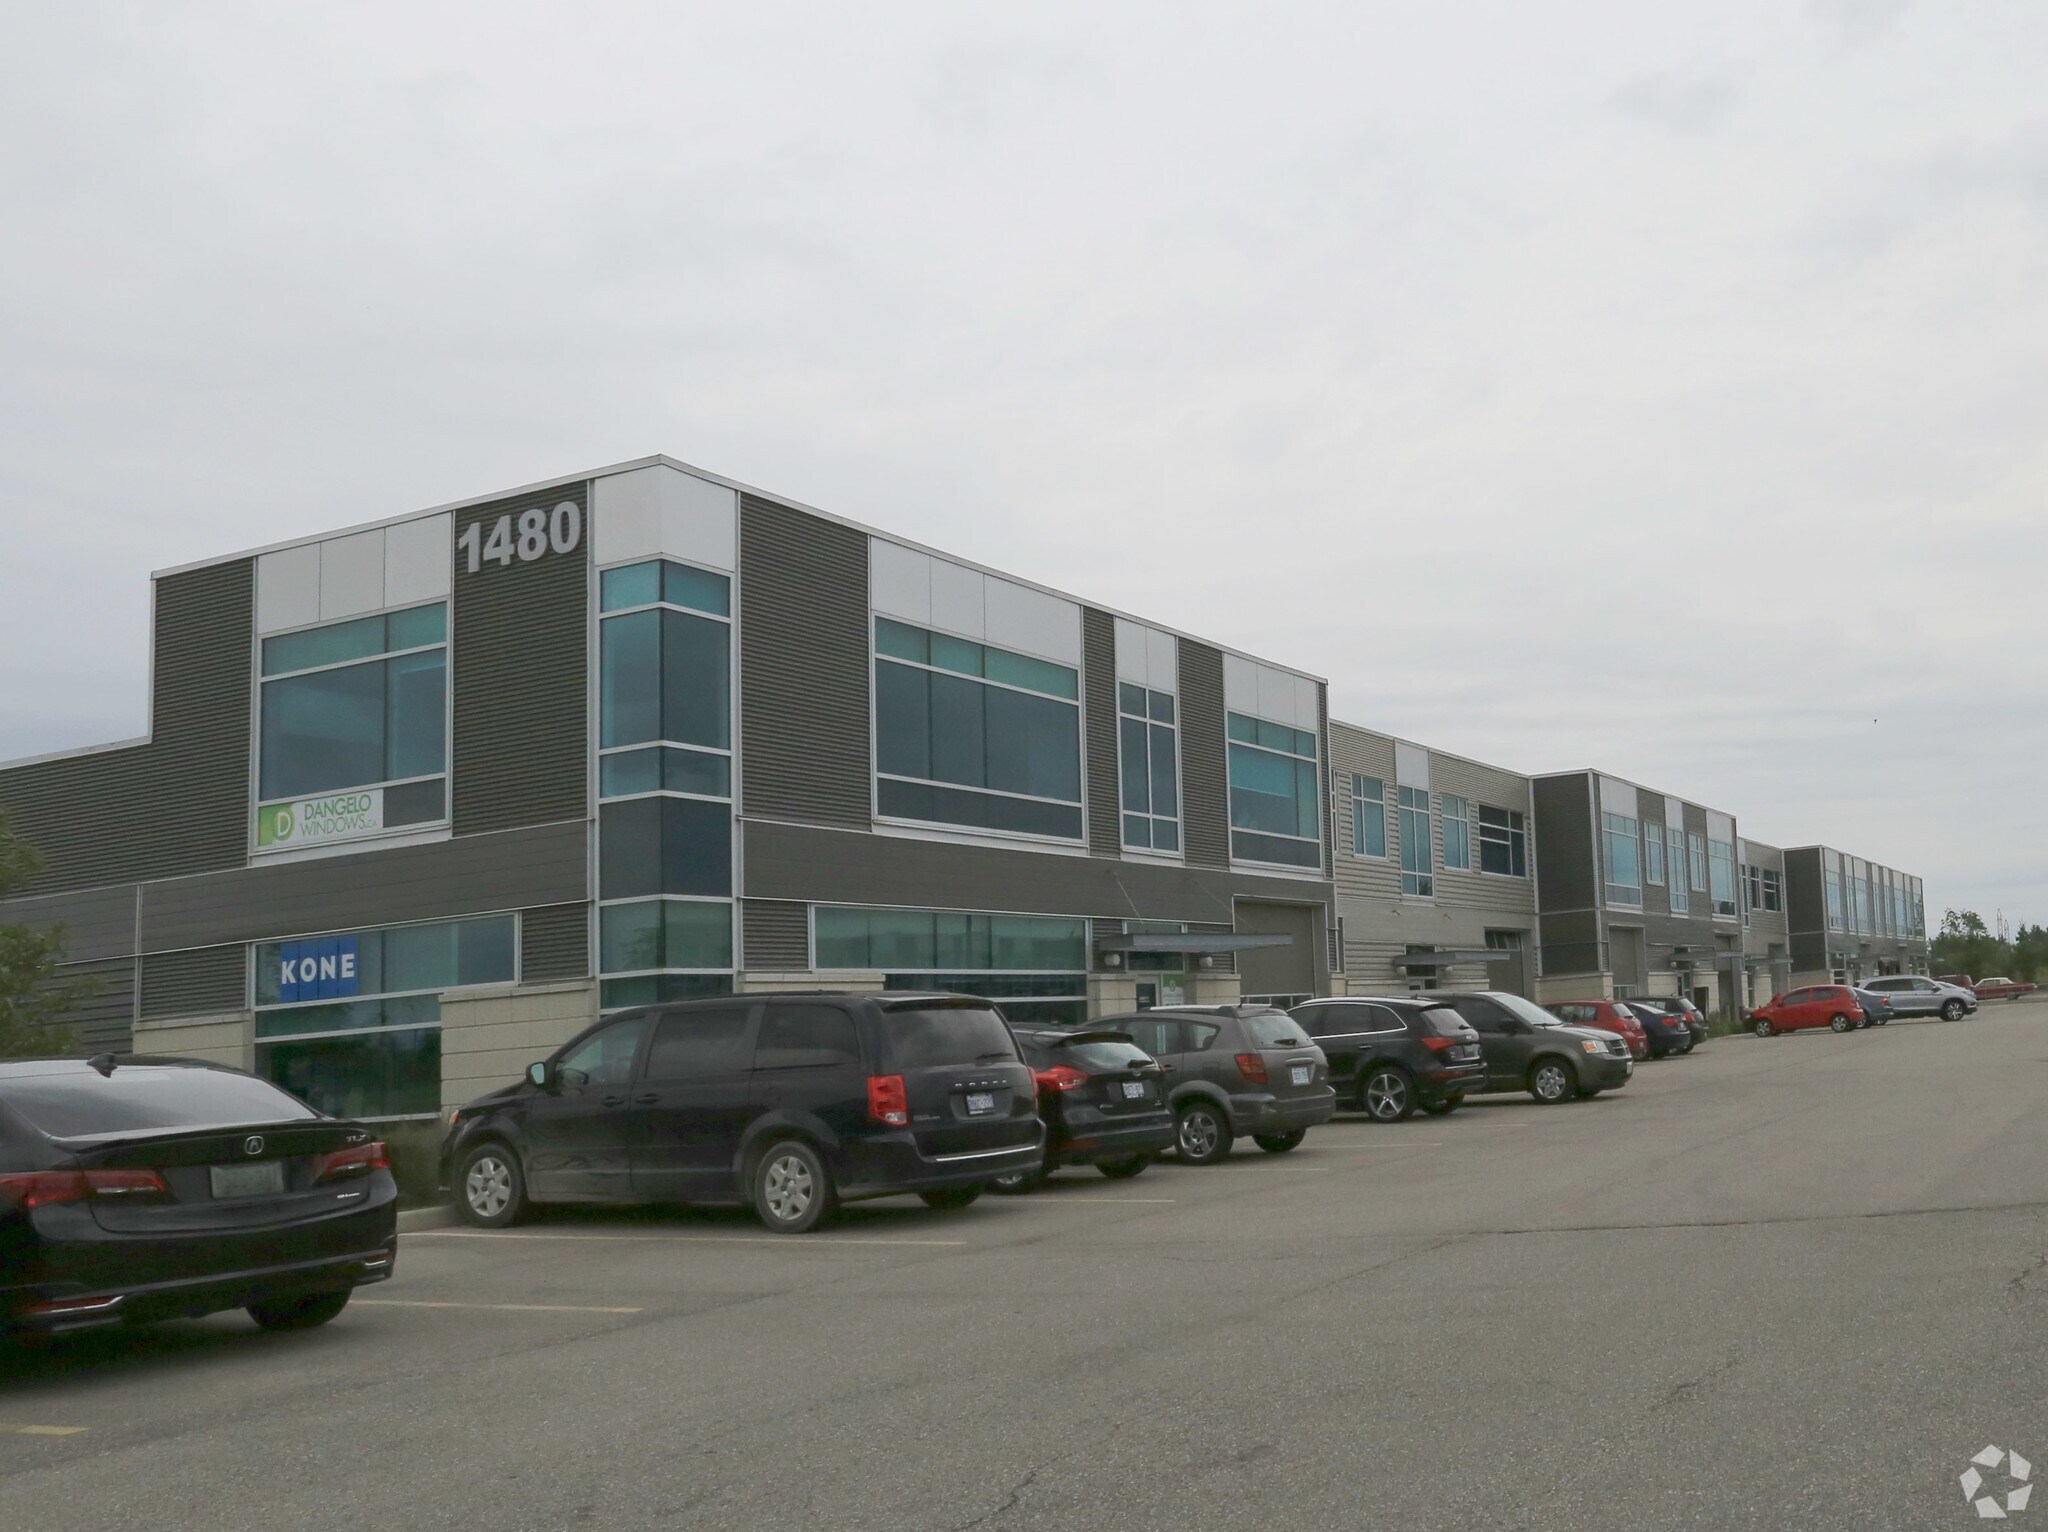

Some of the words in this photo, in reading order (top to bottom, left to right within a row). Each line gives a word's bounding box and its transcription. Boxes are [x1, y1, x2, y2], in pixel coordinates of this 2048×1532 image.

[458, 501, 581, 573] 1480
[304, 794, 371, 820] DANGELO
[281, 953, 355, 985] KONE
